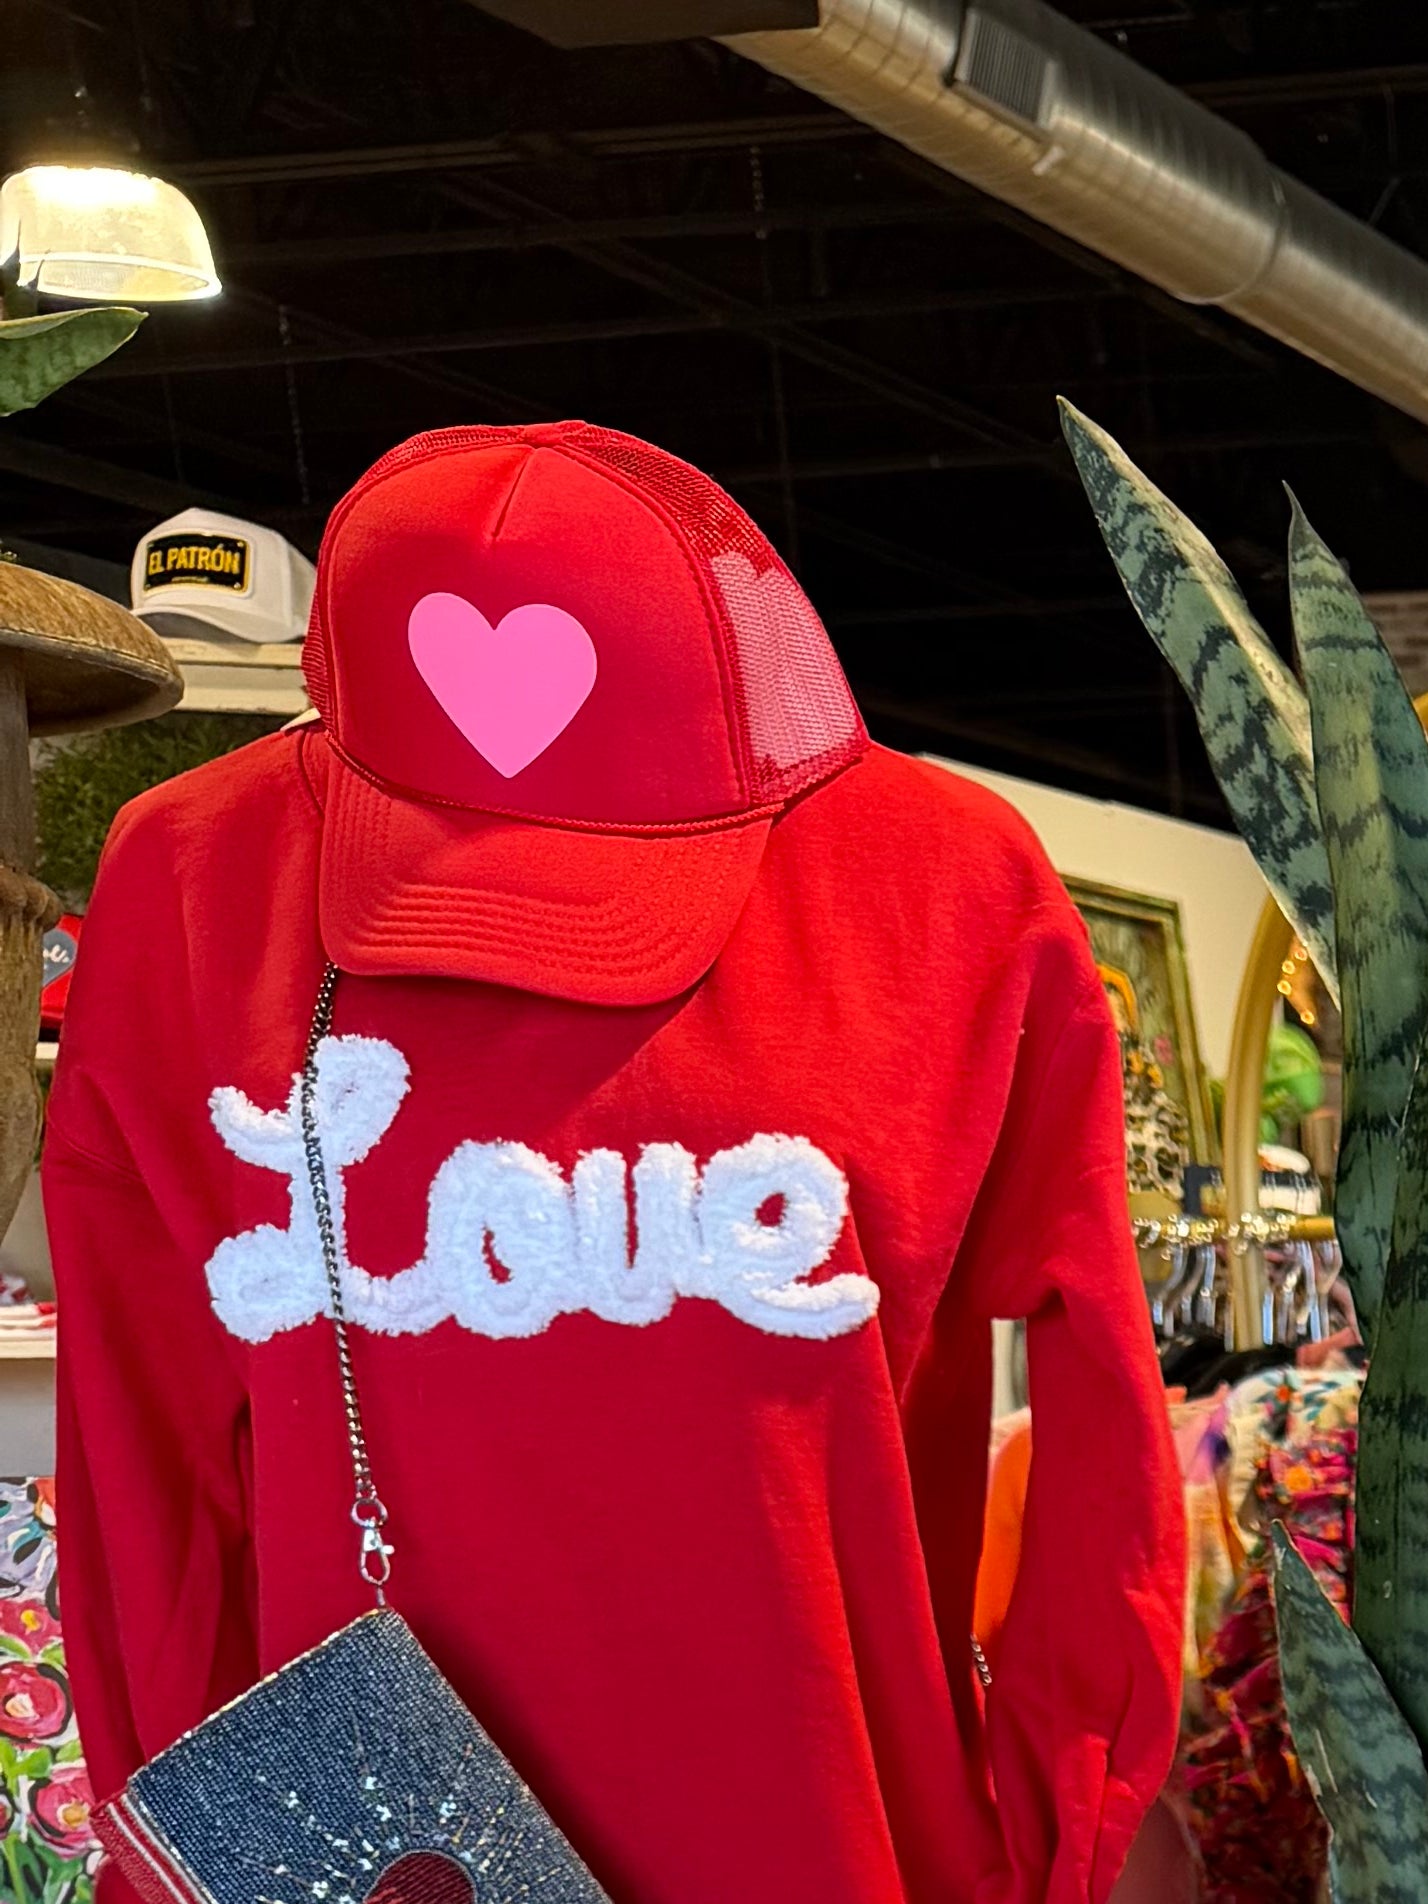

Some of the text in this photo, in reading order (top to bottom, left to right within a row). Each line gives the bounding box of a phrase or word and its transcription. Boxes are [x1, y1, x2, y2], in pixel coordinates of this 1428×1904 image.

[148, 543, 240, 576] EL PATRÓN
[203, 1033, 882, 1344] Love
